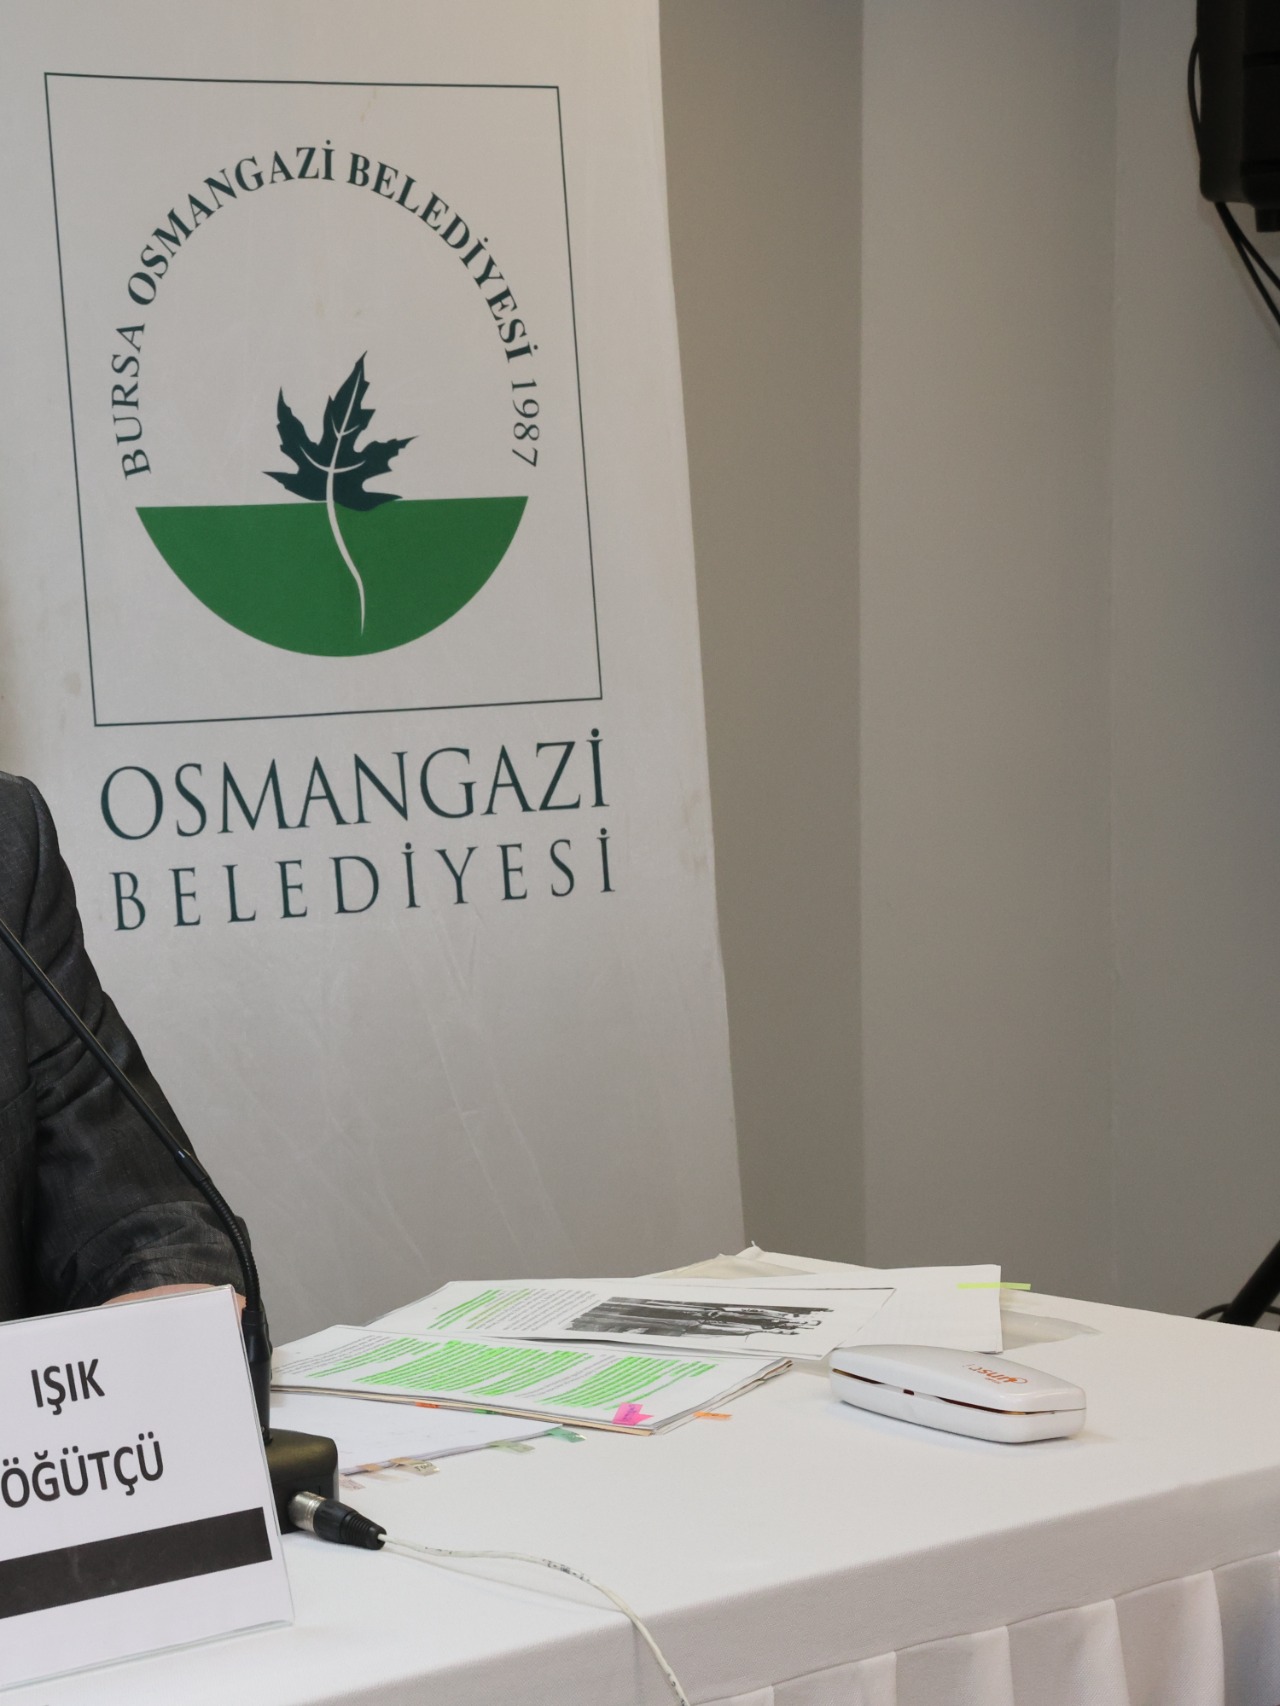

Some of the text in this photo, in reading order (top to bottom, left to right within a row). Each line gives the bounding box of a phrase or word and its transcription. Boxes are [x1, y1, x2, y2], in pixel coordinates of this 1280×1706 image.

[111, 139, 540, 480] BURSA OSMANGAZİ BELEDİYESİ 1987
[100, 728, 610, 840] OSMANGAZİ
[108, 828, 615, 931] BELEDİYESİ
[30, 1358, 105, 1415] IŞIK
[0, 1431, 164, 1508] ÖĞÜTÇÜ
